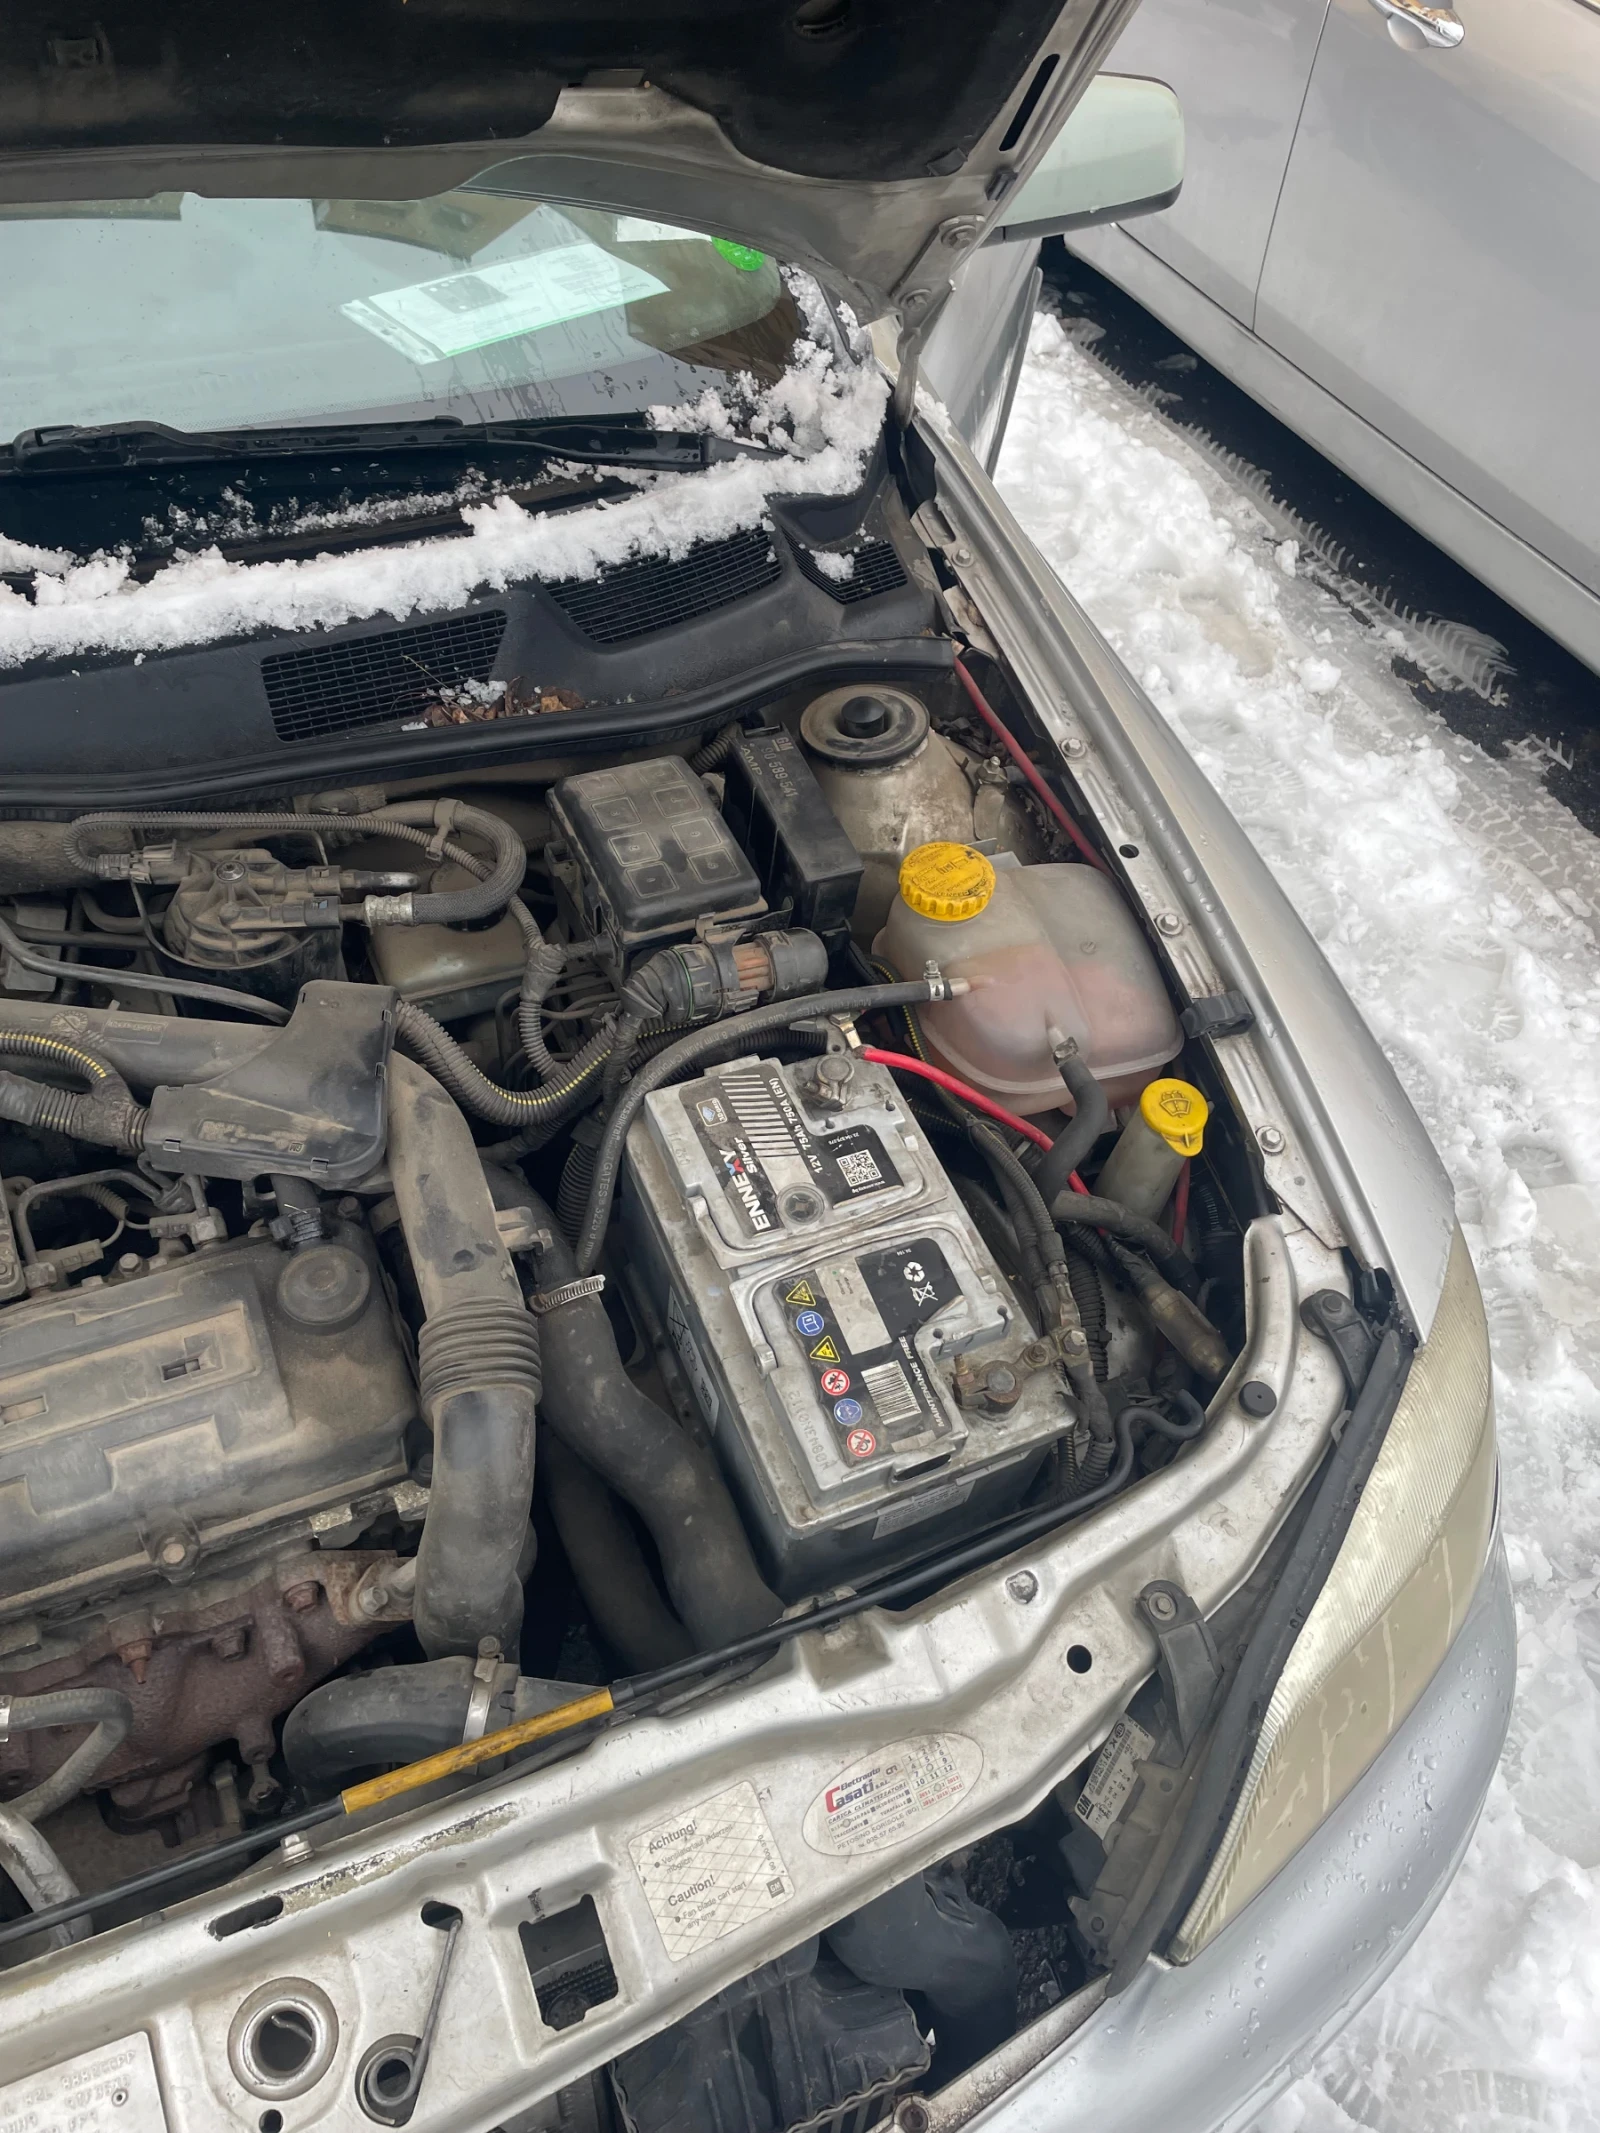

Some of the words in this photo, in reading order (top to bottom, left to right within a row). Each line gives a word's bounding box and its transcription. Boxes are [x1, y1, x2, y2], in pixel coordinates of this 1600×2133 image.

[740, 743, 763, 777] AMP
[760, 744, 776, 762] 90
[768, 758, 788, 782] 589
[768, 1076, 786, 1099] (EN)
[779, 1098, 797, 1124] 750A
[792, 1123, 811, 1151] 75Ah
[733, 1134, 758, 1175] Silver
[806, 1151, 823, 1174] 12V
[718, 1142, 771, 1232] ENNEXY
[897, 1335, 914, 1360] FREE
[909, 1360, 945, 1428] MAINTENANCE
[840, 1767, 881, 1791] Elettrauto
[915, 1777, 926, 1786] 10
[928, 1770, 939, 1780] 11
[942, 1763, 953, 1773] 12
[825, 1779, 874, 1813] Casati
[826, 1808, 853, 1825] CARICA
[852, 1781, 908, 1811] CLIMATIZZATORI
[1076, 1794, 1092, 1816] GM
[645, 1819, 700, 1855] Achtung!
[835, 1830, 871, 1850] PETOSINO
[664, 1855, 693, 1875] möglich
[665, 1874, 717, 1907] Caution!
[681, 1907, 696, 1919] Fan
[696, 1896, 717, 1912] blade
[716, 1890, 730, 1900] can
[730, 1880, 747, 1893] start
[685, 1918, 699, 1930] any
